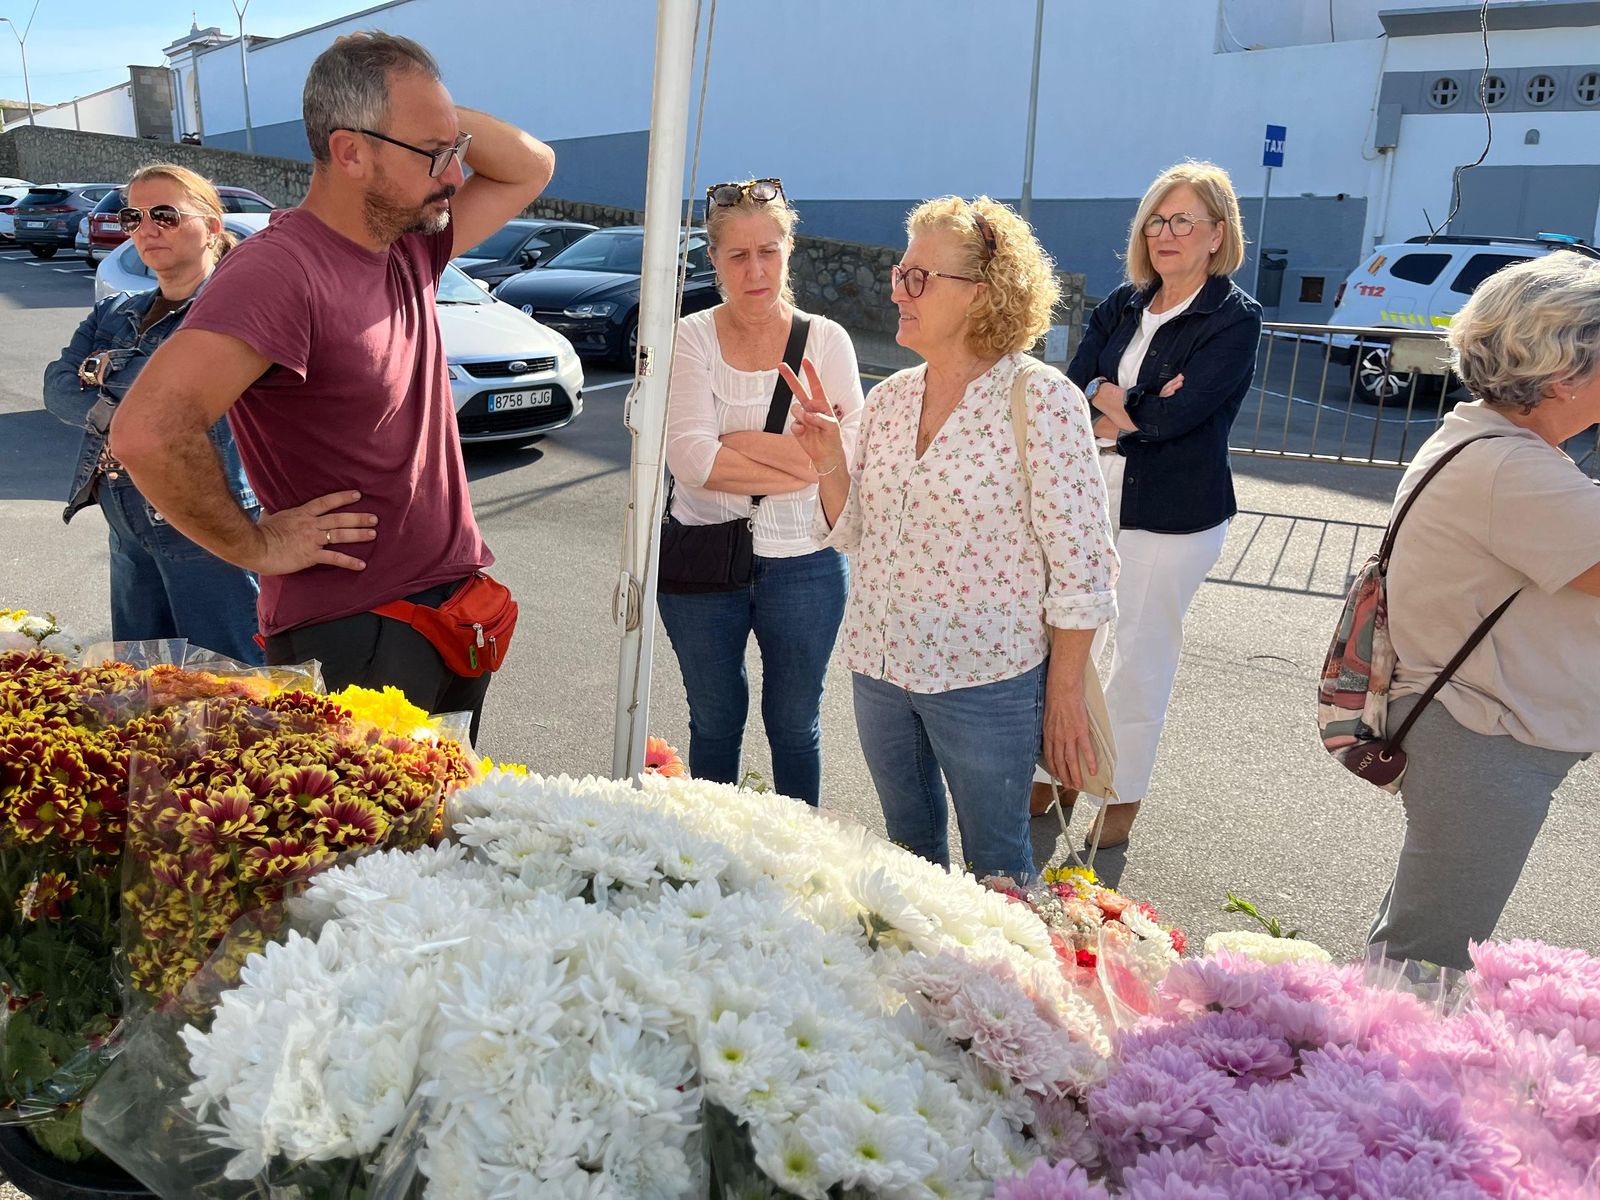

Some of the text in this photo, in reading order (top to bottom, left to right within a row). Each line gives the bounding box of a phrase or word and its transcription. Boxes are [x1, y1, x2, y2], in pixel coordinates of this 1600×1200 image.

[1360, 286, 1385, 297] 112
[495, 391, 550, 409] 8758 GJG
